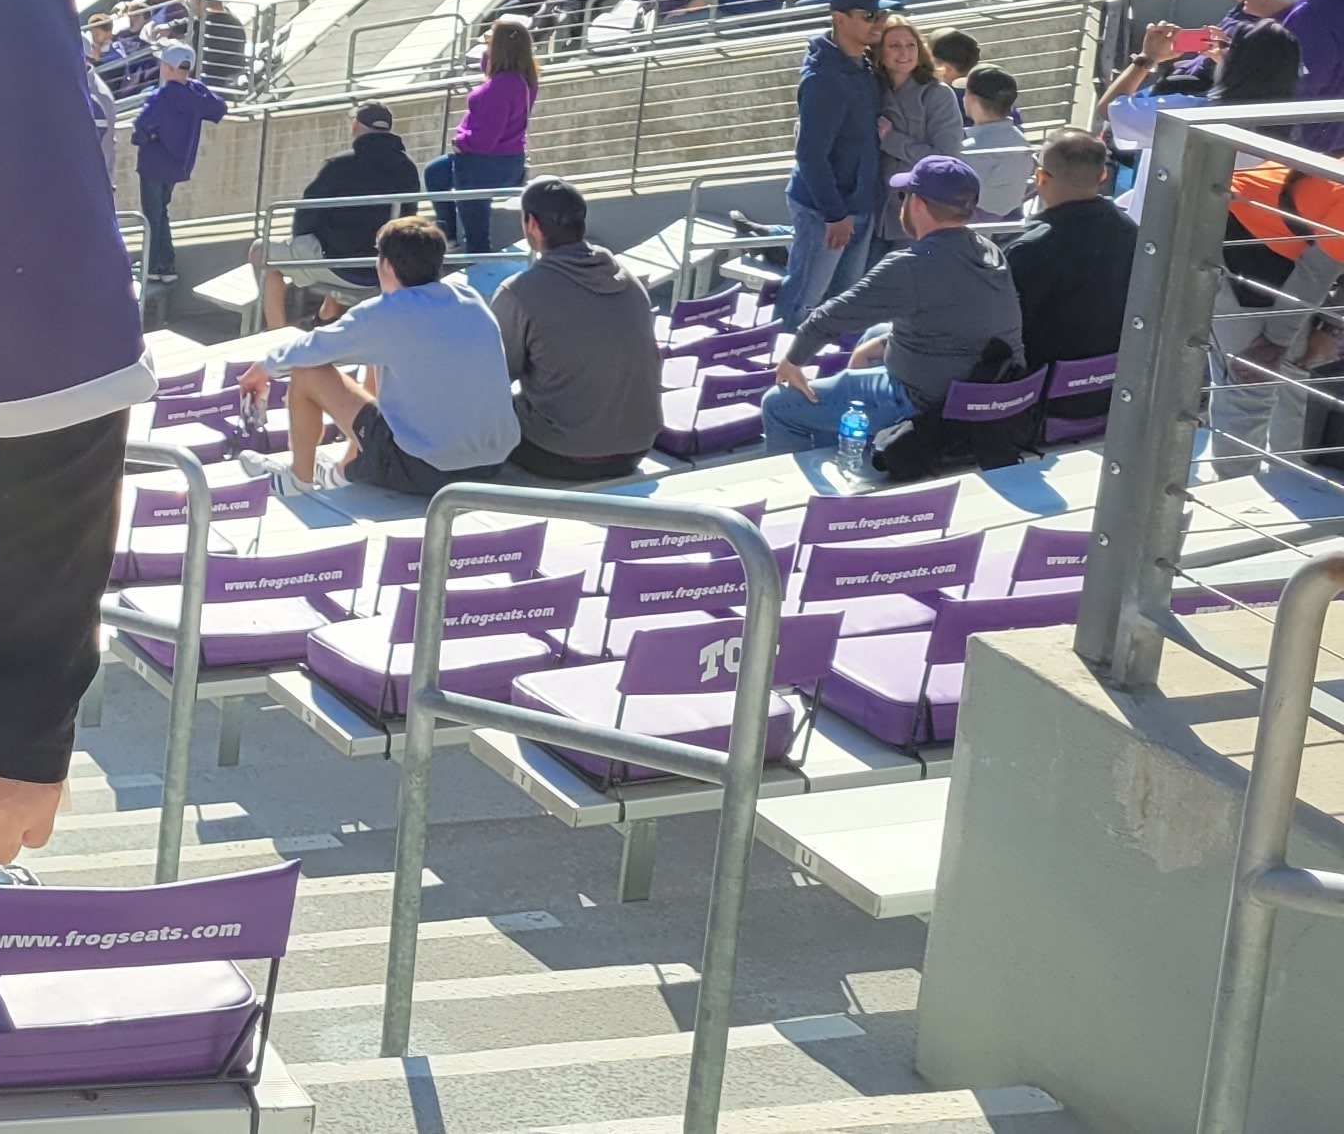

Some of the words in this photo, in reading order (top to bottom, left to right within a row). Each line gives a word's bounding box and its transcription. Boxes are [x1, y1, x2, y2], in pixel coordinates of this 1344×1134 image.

[828, 510, 935, 532] www.frogseats.com
[223, 568, 344, 594] www.frogseats.com
[835, 562, 957, 588] www.frogseats.com
[801, 849, 812, 868] U
